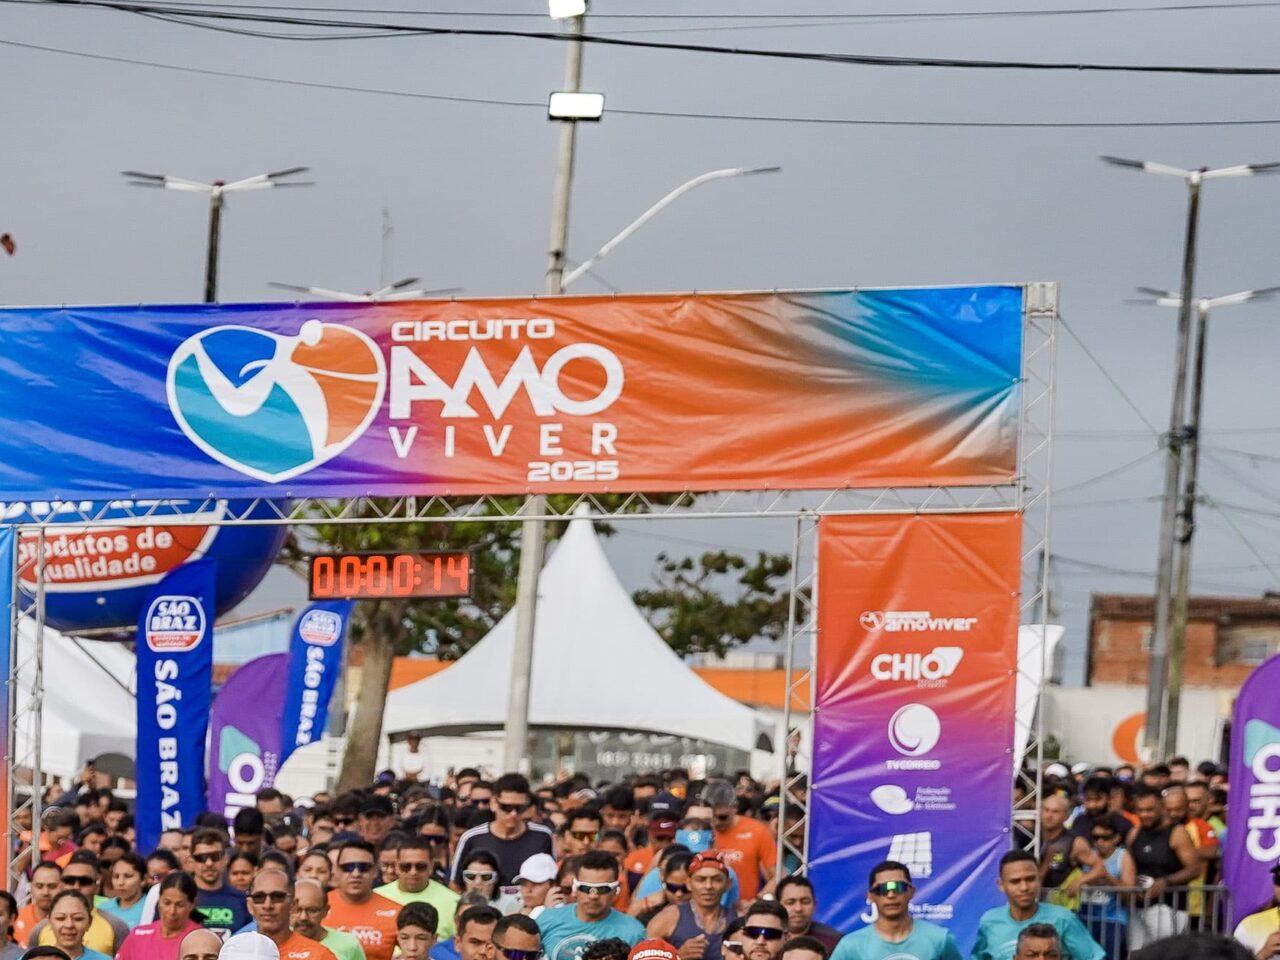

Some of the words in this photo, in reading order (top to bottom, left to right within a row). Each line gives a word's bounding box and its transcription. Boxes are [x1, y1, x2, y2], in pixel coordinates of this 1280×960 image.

[390, 318, 555, 342] CIRCUITO
[388, 342, 625, 420] AMO
[388, 422, 618, 459] VIVER
[527, 460, 619, 483] 2025
[19, 532, 129, 564] produtos
[136, 527, 173, 549] de
[33, 553, 157, 583] qualidade
[313, 555, 469, 597] 00:00:14
[151, 615, 198, 631] BRAZ
[870, 653, 946, 681] CHIO
[155, 659, 183, 731] SÃO
[158, 737, 182, 832] BRAZ
[1246, 742, 1280, 863] CHIO
